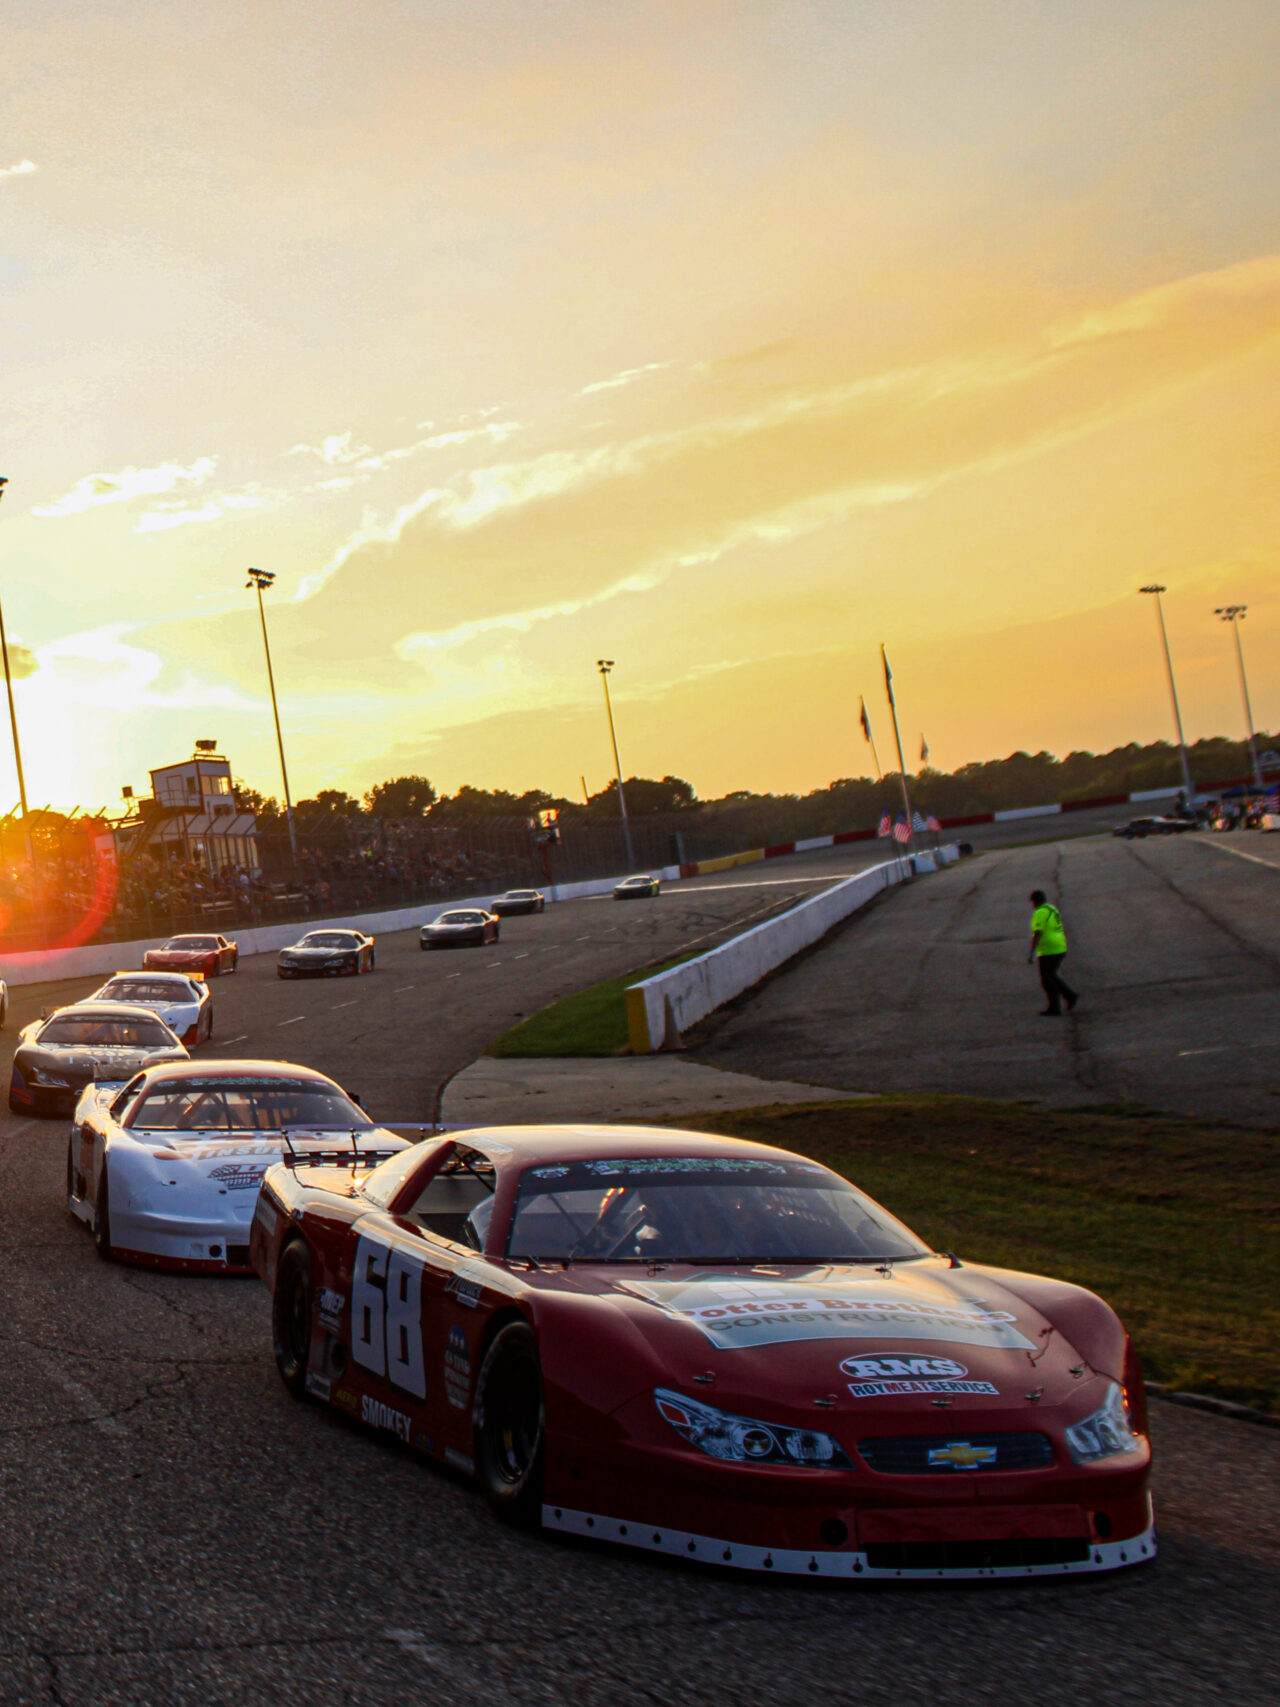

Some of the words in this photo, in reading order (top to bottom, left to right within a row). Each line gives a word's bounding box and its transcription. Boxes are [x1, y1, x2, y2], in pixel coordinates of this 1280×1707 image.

[351, 1234, 427, 1400] 68
[707, 1313, 1004, 1333] CONSTRUCTION
[845, 1359, 963, 1377] RMS
[361, 1394, 412, 1444] SMOKEY
